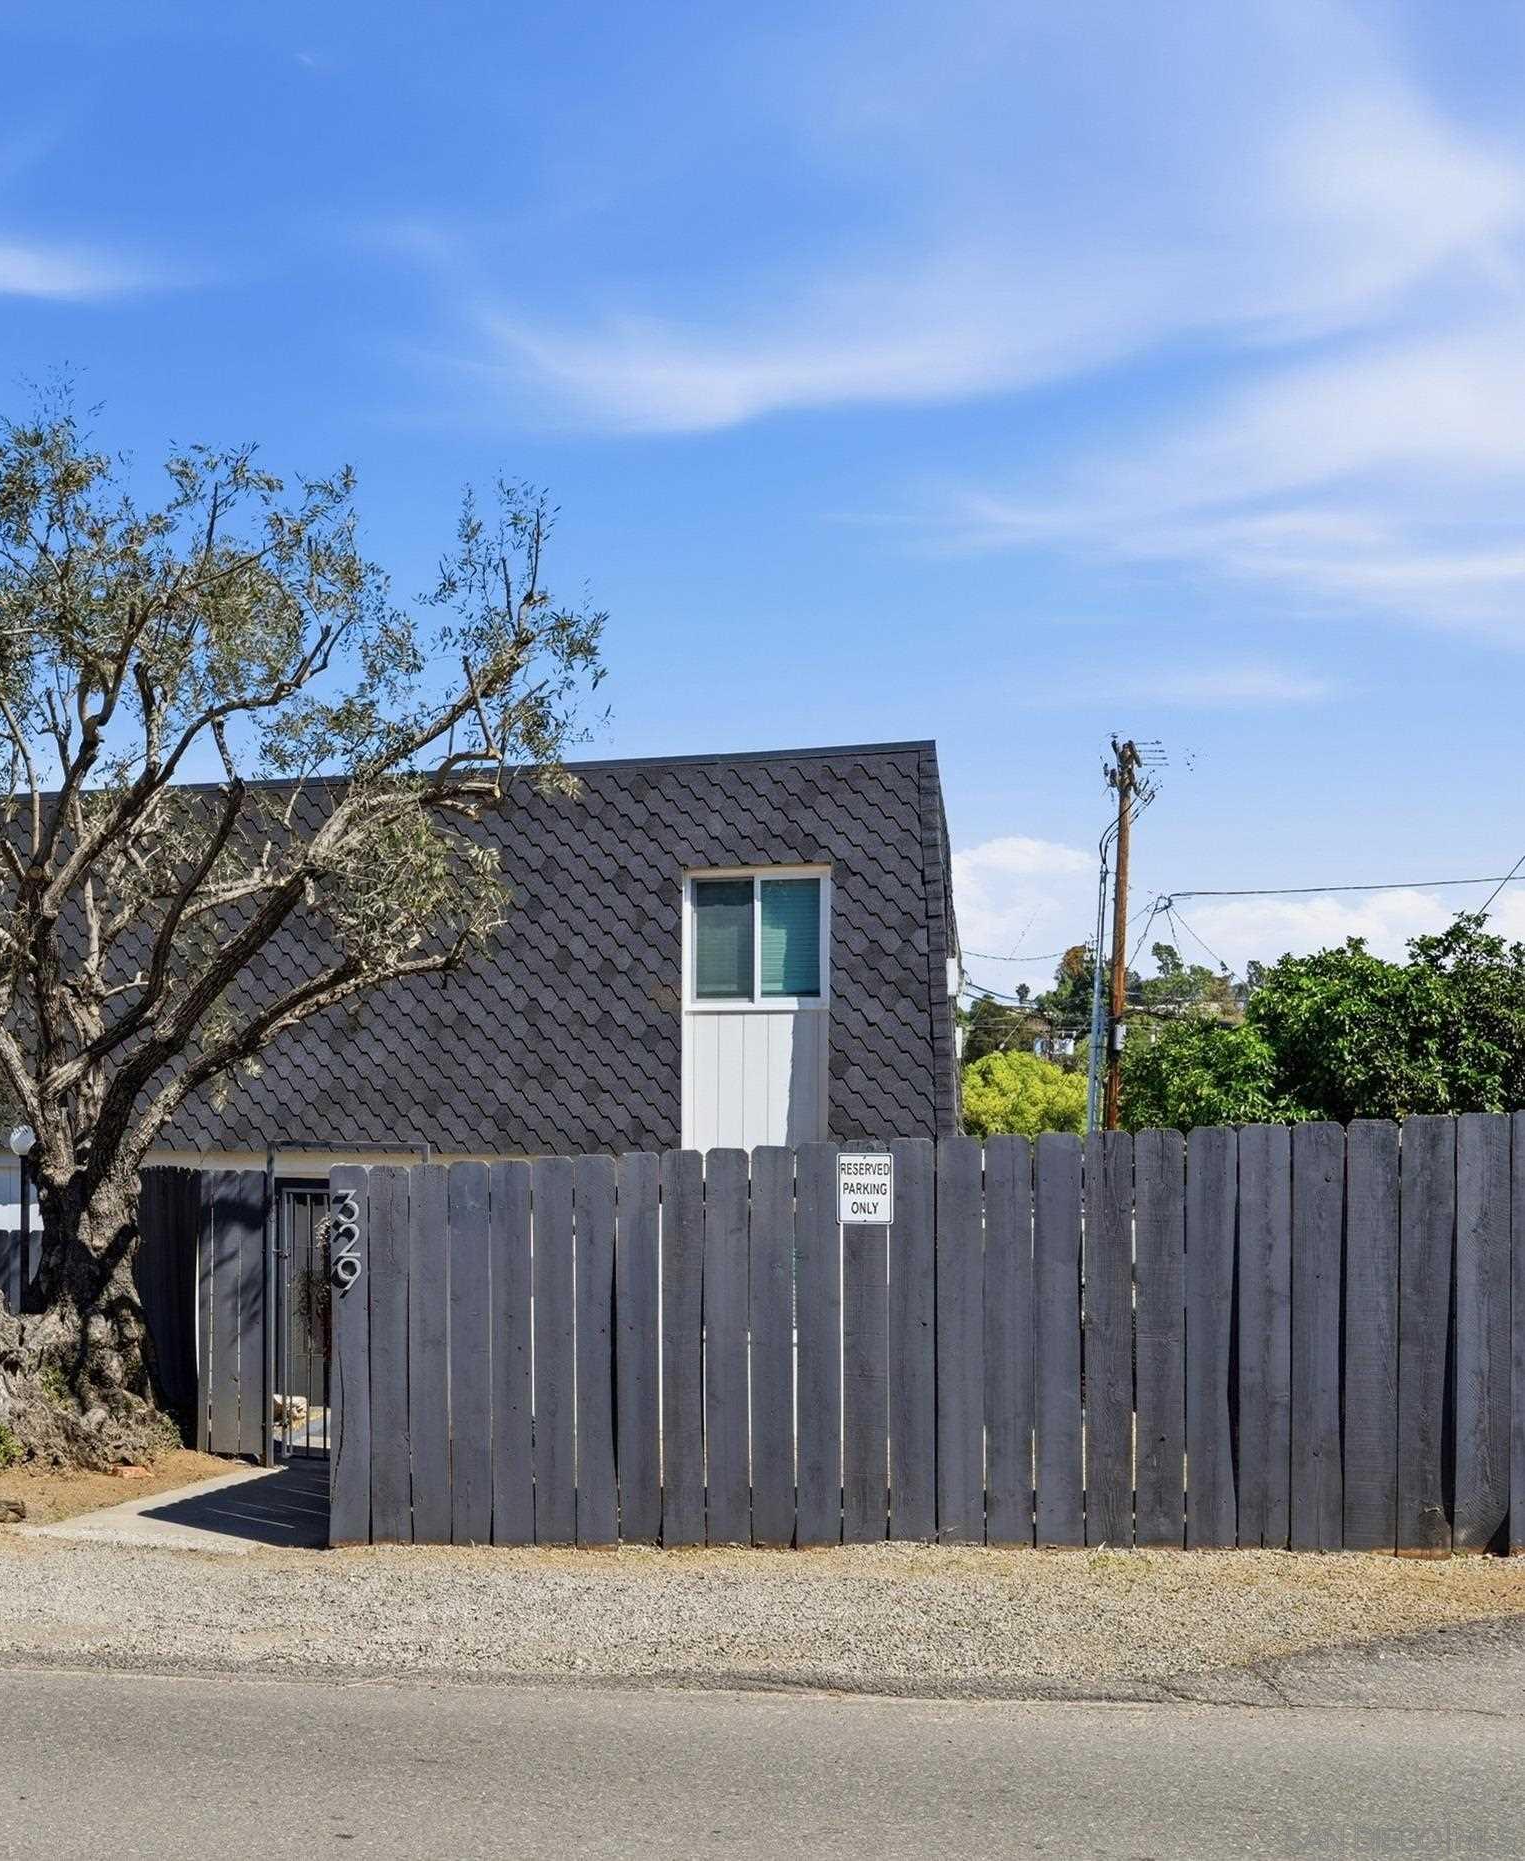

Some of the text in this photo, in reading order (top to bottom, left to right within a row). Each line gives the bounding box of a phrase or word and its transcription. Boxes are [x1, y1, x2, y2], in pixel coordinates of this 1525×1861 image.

[841, 1163, 890, 1175] RESERVED
[843, 1183, 888, 1195] PARKING
[851, 1202, 879, 1214] ONLY
[337, 1189, 362, 1290] 329
